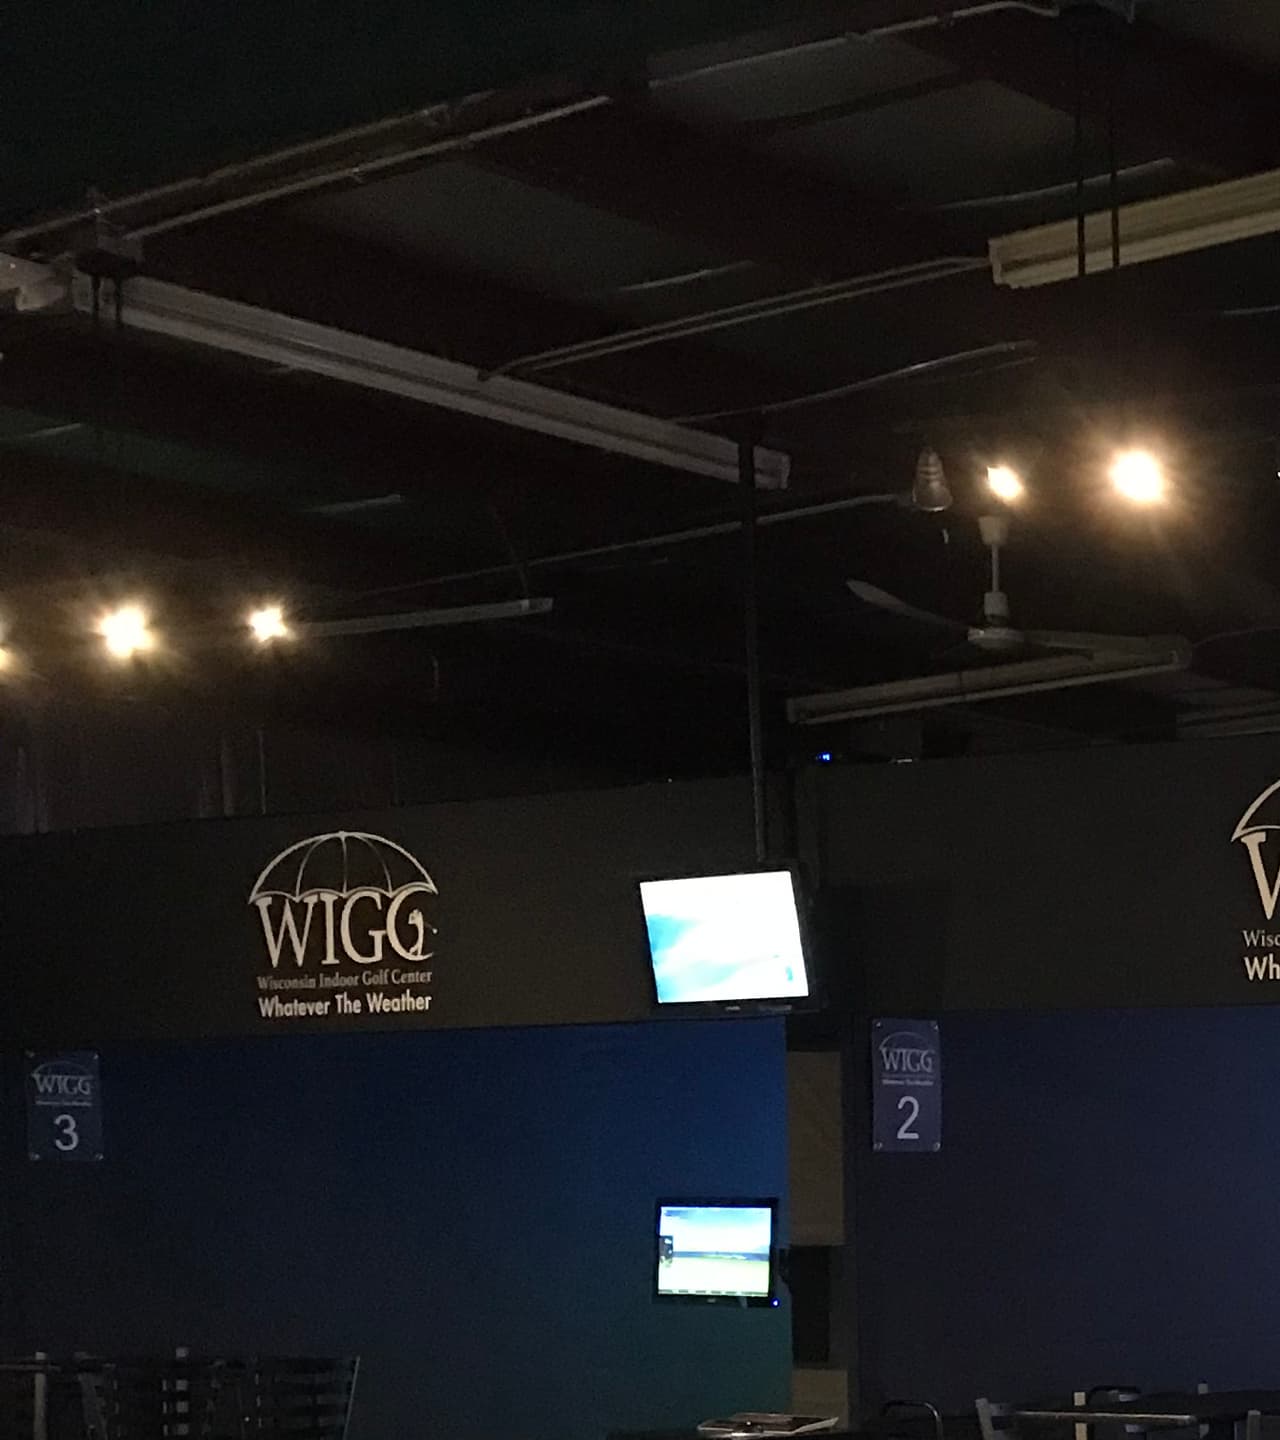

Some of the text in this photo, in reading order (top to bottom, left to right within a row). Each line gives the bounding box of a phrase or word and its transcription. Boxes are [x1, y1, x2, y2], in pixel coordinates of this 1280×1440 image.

[257, 969, 433, 990] Wisconsin Indoor Golf Center
[258, 989, 432, 1018] Whatever The Weather
[54, 1114, 79, 1151] 3
[897, 1095, 919, 1140] 2
